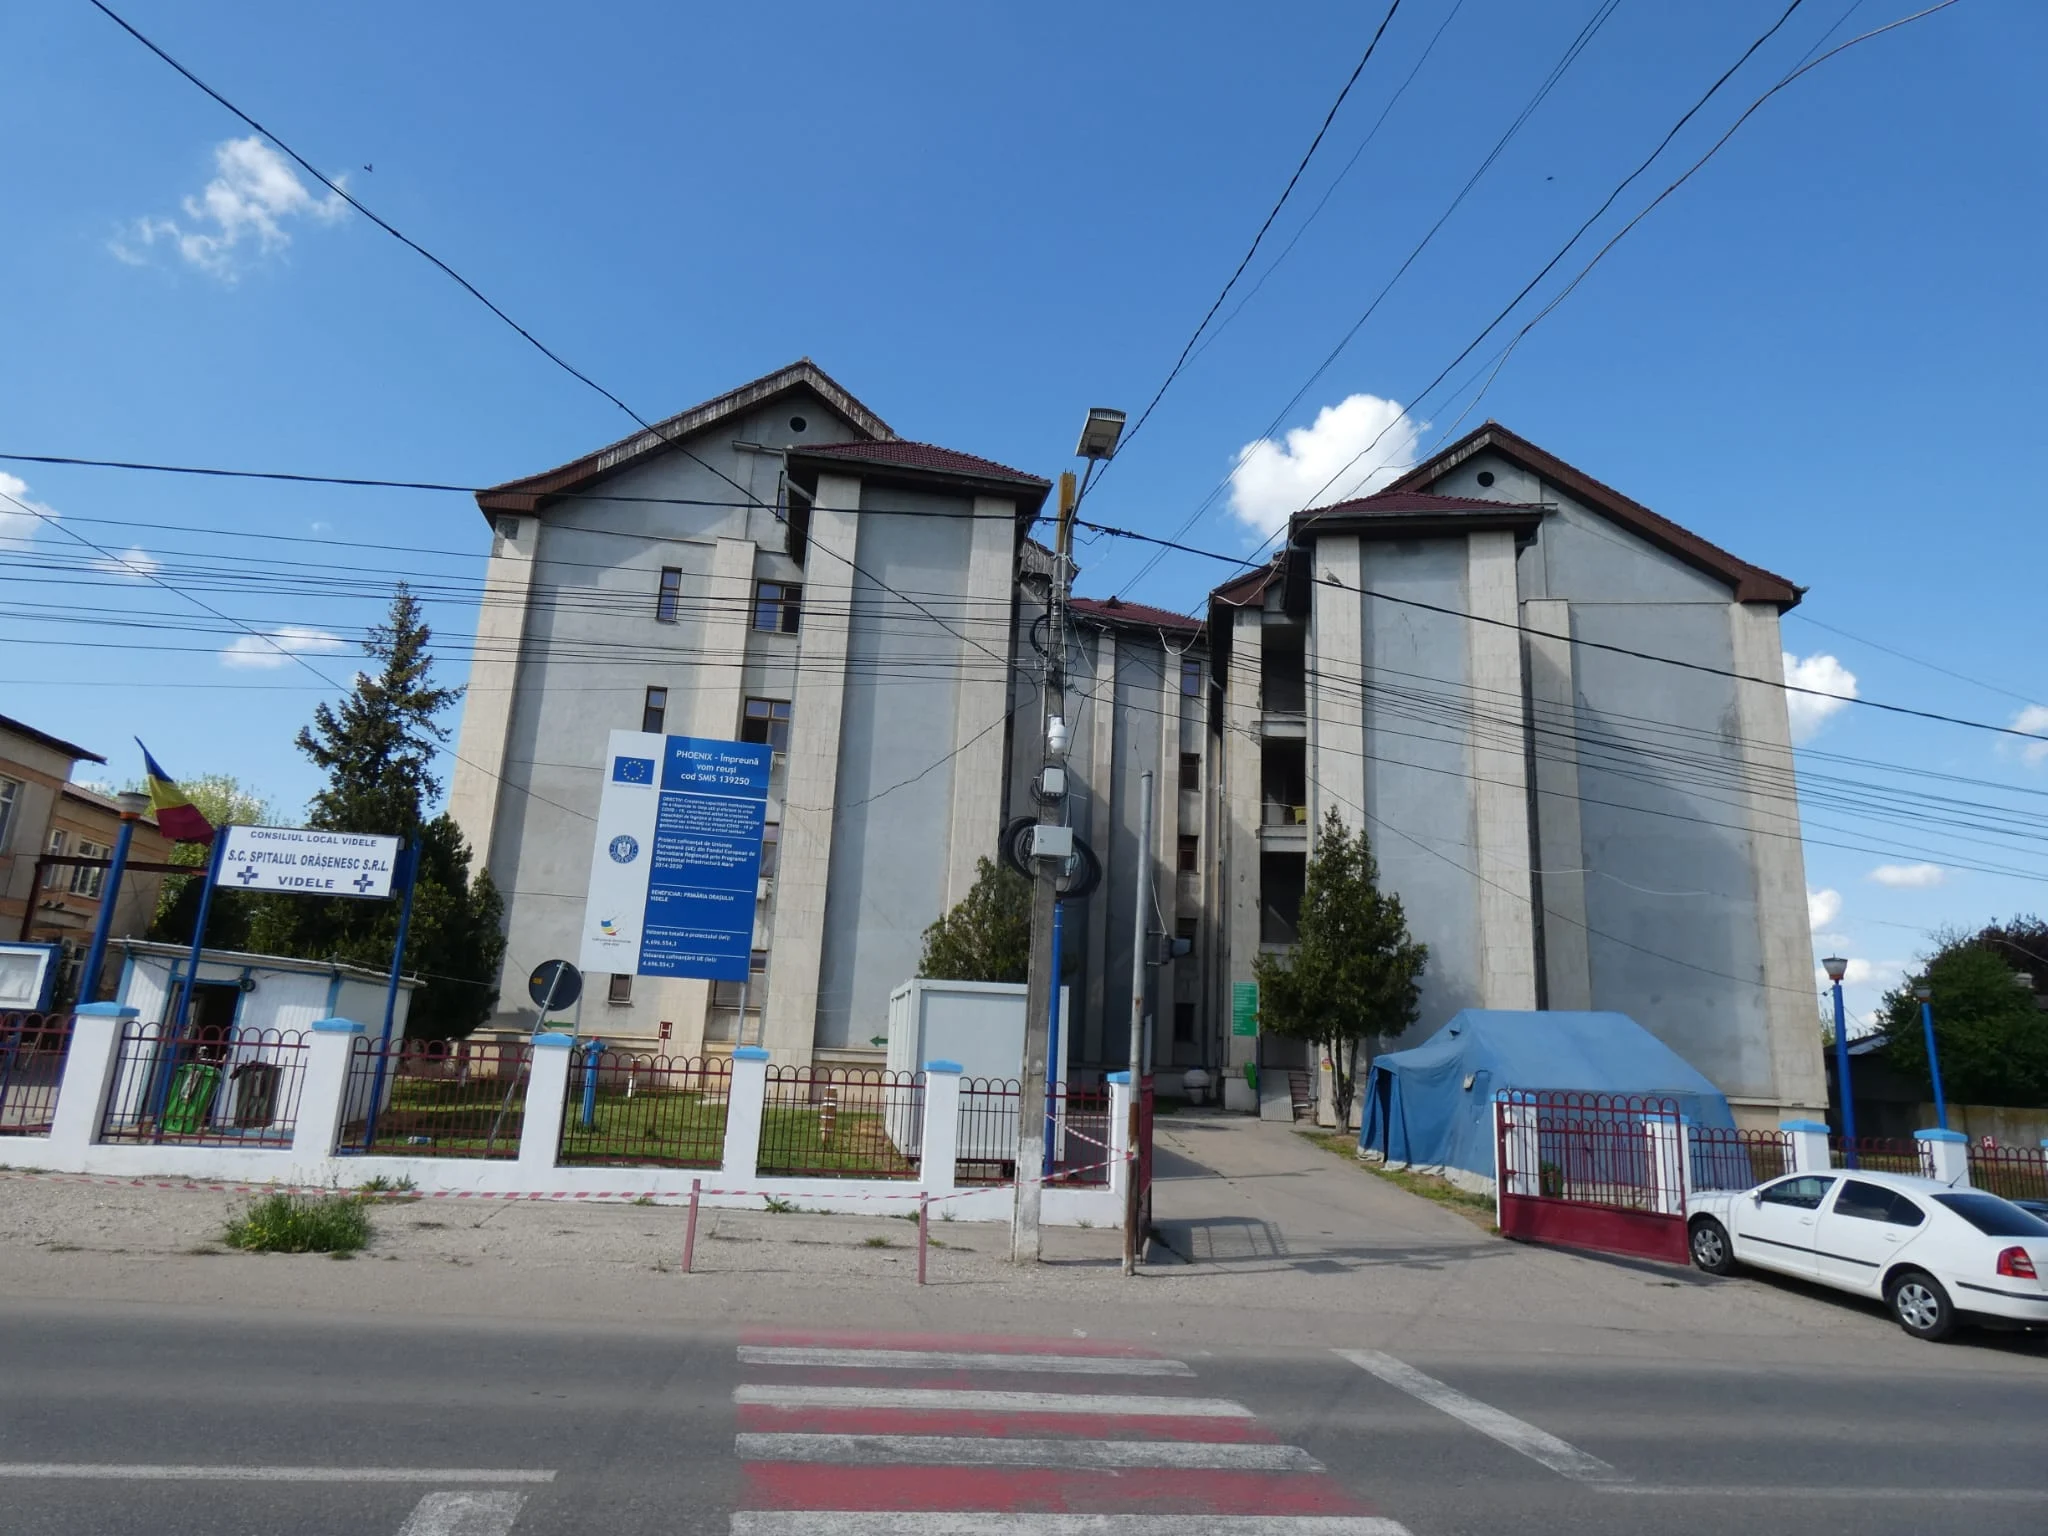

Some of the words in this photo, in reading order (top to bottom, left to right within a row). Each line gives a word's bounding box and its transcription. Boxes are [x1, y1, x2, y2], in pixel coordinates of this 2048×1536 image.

[676, 750, 712, 761] PHOENIX
[720, 753, 759, 766] Împreună
[680, 772, 696, 780] cod
[698, 774, 716, 782] SMIS
[720, 776, 750, 786] 139250
[250, 830, 303, 842] CONSILIUL
[307, 835, 339, 845] LOCAL
[342, 838, 377, 847] VIDELE
[228, 850, 247, 862] S.C.
[250, 851, 297, 865] SPITALUL
[362, 859, 389, 872] S.R.L.
[278, 876, 335, 889] VIDELE
